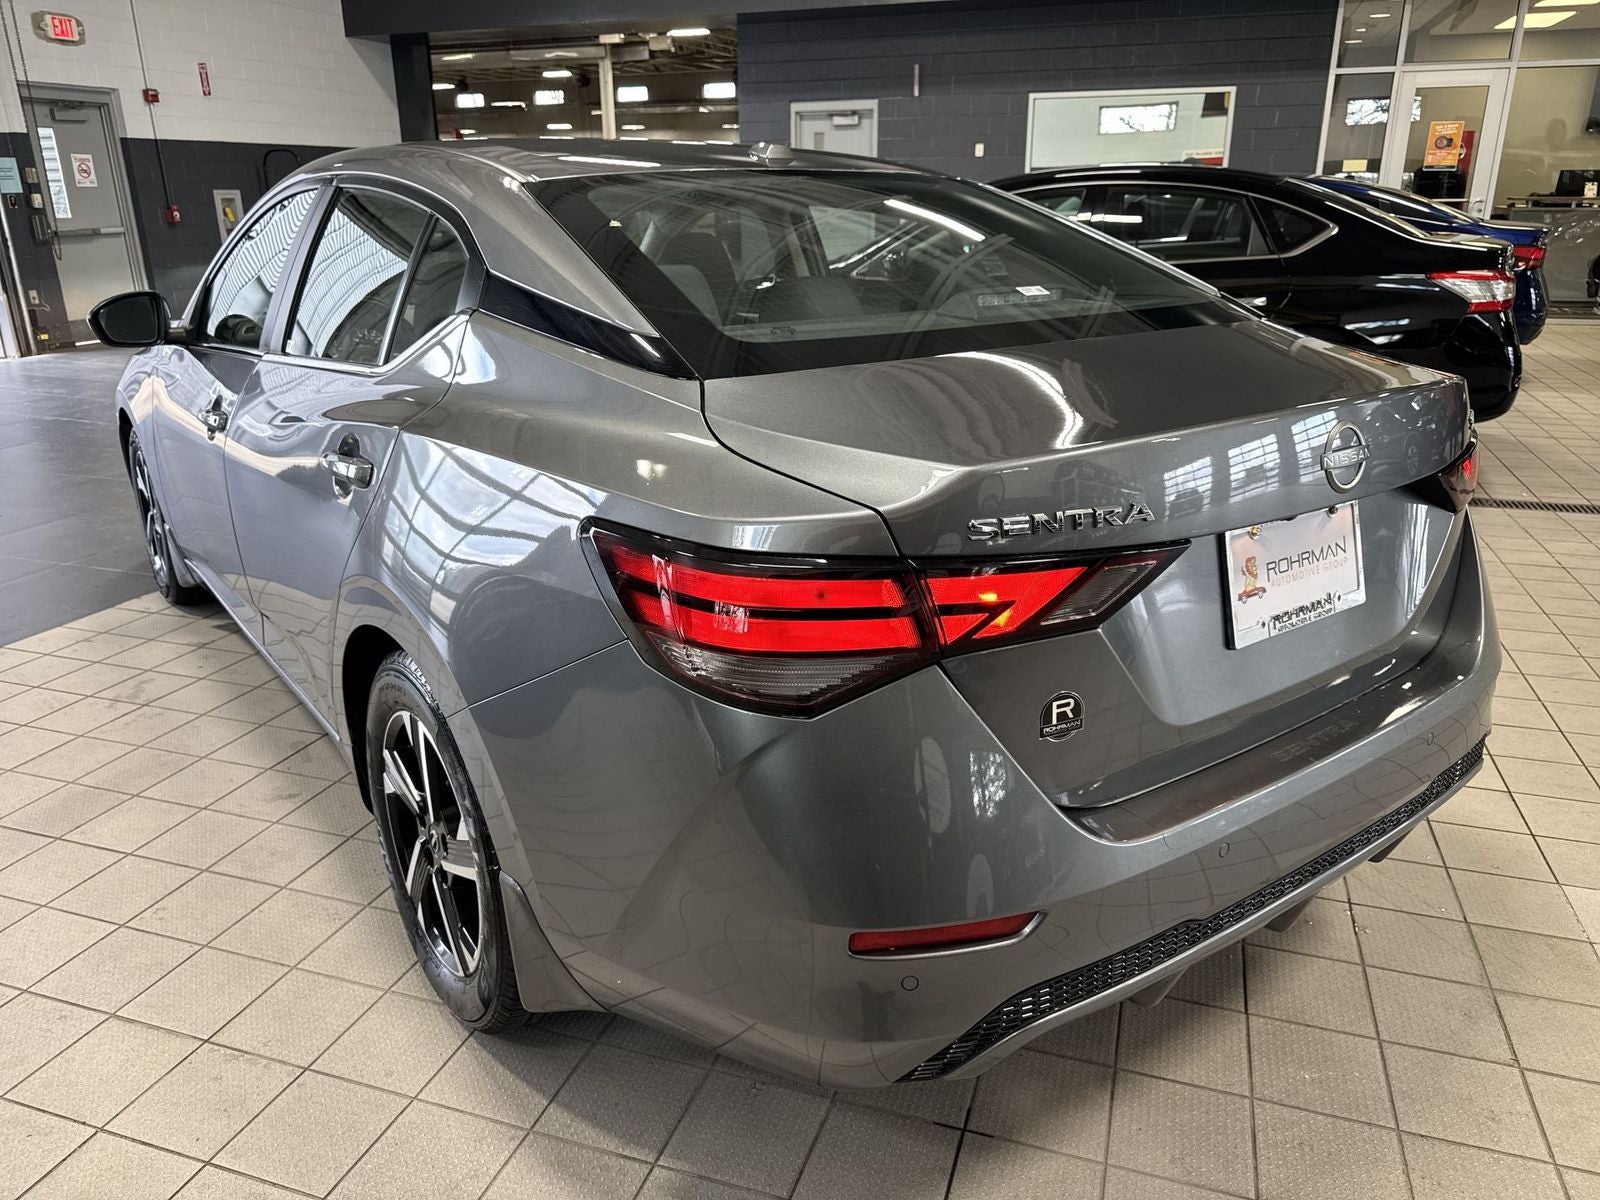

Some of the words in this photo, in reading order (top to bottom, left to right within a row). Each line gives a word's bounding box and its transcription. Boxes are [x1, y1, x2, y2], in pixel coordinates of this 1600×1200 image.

[51, 16, 74, 38] EXIT
[1323, 447, 1370, 468] NISSAN
[966, 502, 1156, 540] SENTRA
[1266, 535, 1347, 583] ROHRMAN
[1271, 565, 1320, 588] AUTOMOTIVE
[1323, 556, 1349, 572] GROUP
[1273, 592, 1333, 630] ROHRMAN
[1043, 719, 1081, 734] ROHRMAN
[1052, 698, 1075, 725] R
[1270, 719, 1360, 762] SENTRA
